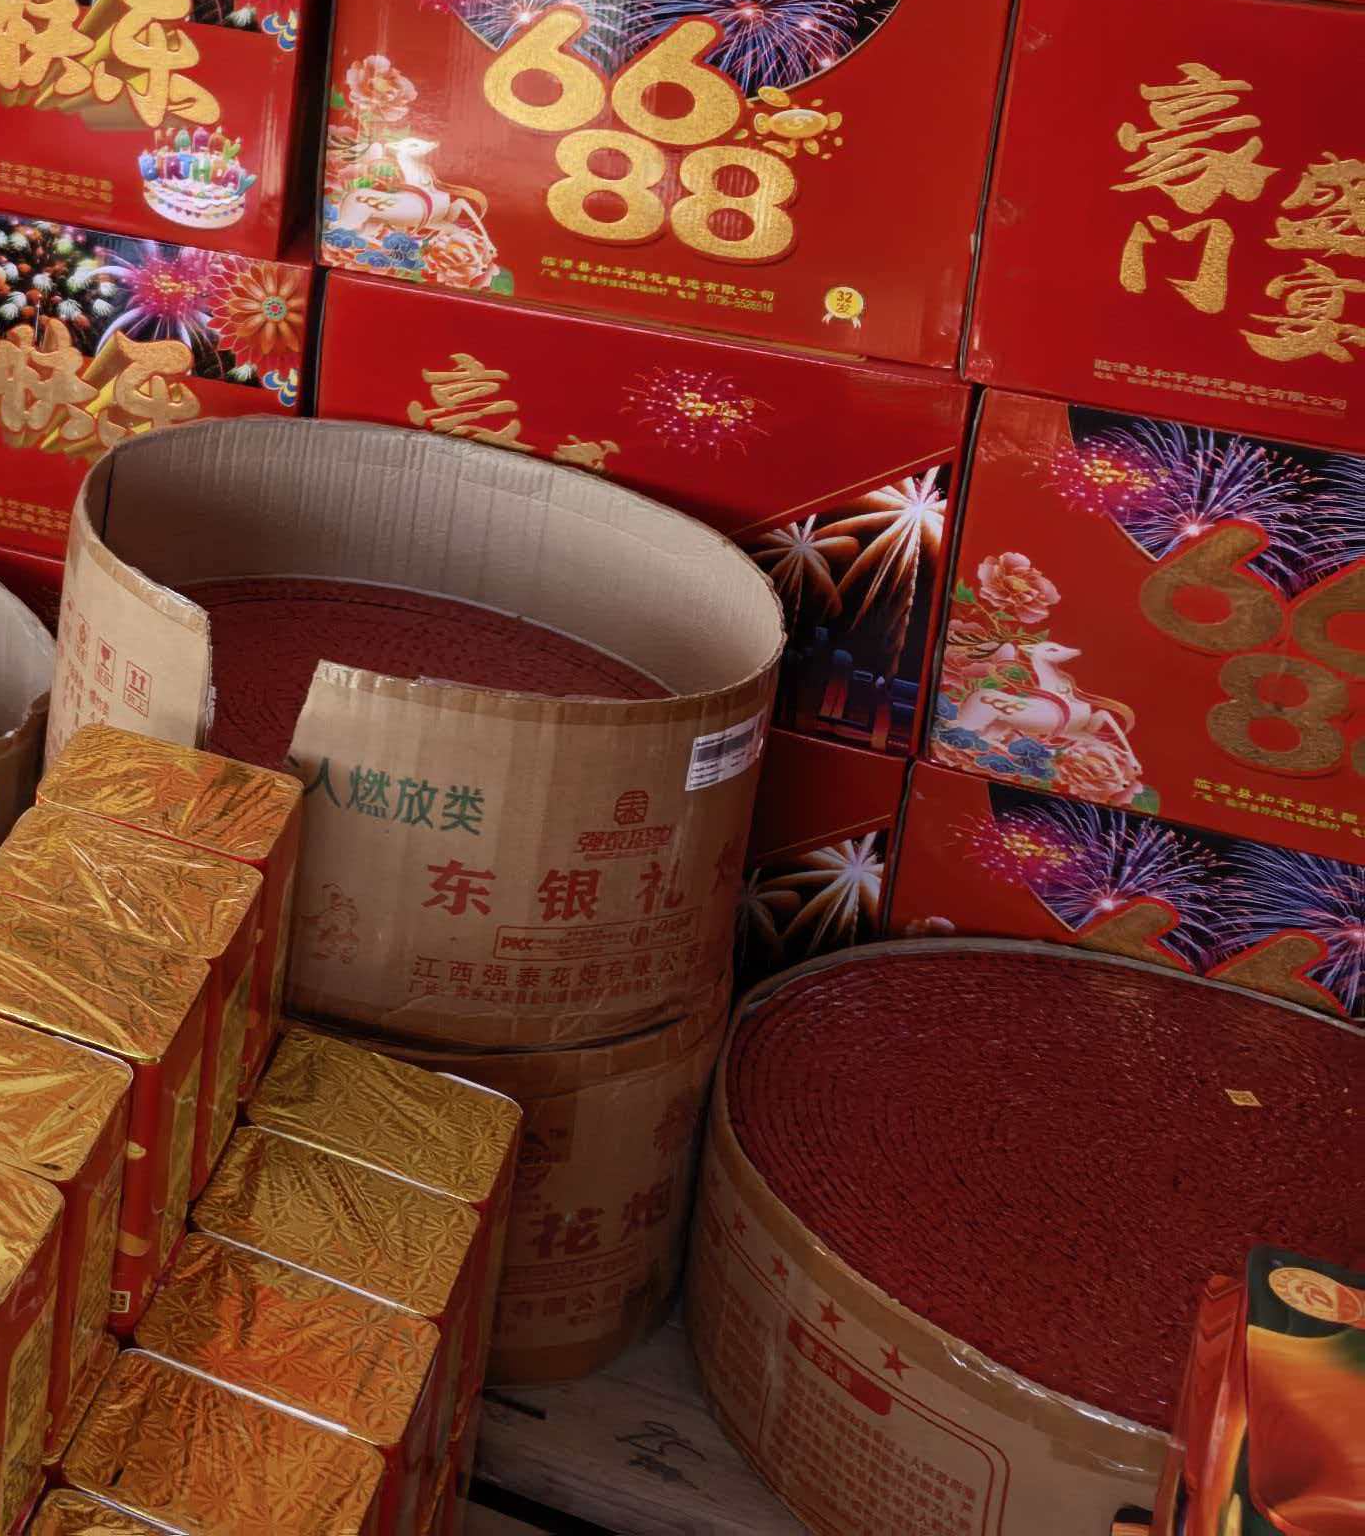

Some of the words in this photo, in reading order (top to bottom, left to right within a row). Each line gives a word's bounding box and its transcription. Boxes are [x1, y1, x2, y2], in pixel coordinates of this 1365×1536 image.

[482, 3, 743, 148] 66
[547, 128, 798, 264] 88
[1110, 62, 1281, 314] 豪门
[287, 755, 485, 836] 人燃放类
